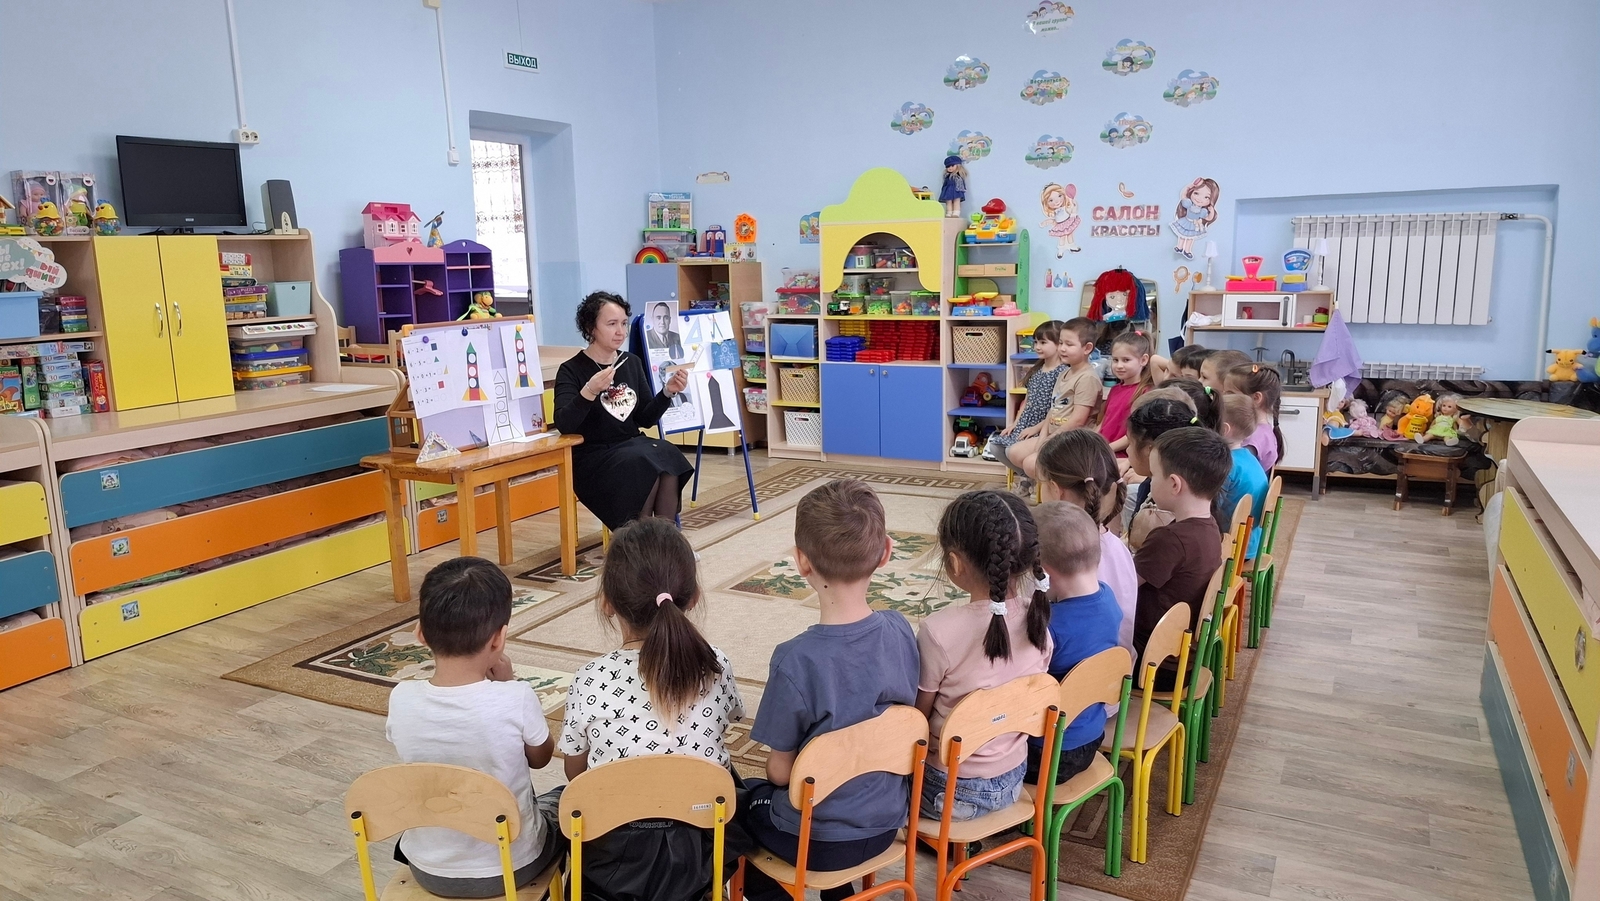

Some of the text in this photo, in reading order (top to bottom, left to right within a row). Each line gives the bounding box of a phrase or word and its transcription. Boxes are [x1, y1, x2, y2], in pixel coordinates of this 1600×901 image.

[508, 53, 537, 68] ВЫХОД
[1092, 205, 1159, 220] САЛОН
[1091, 224, 1161, 237] КРАСОТЫ
